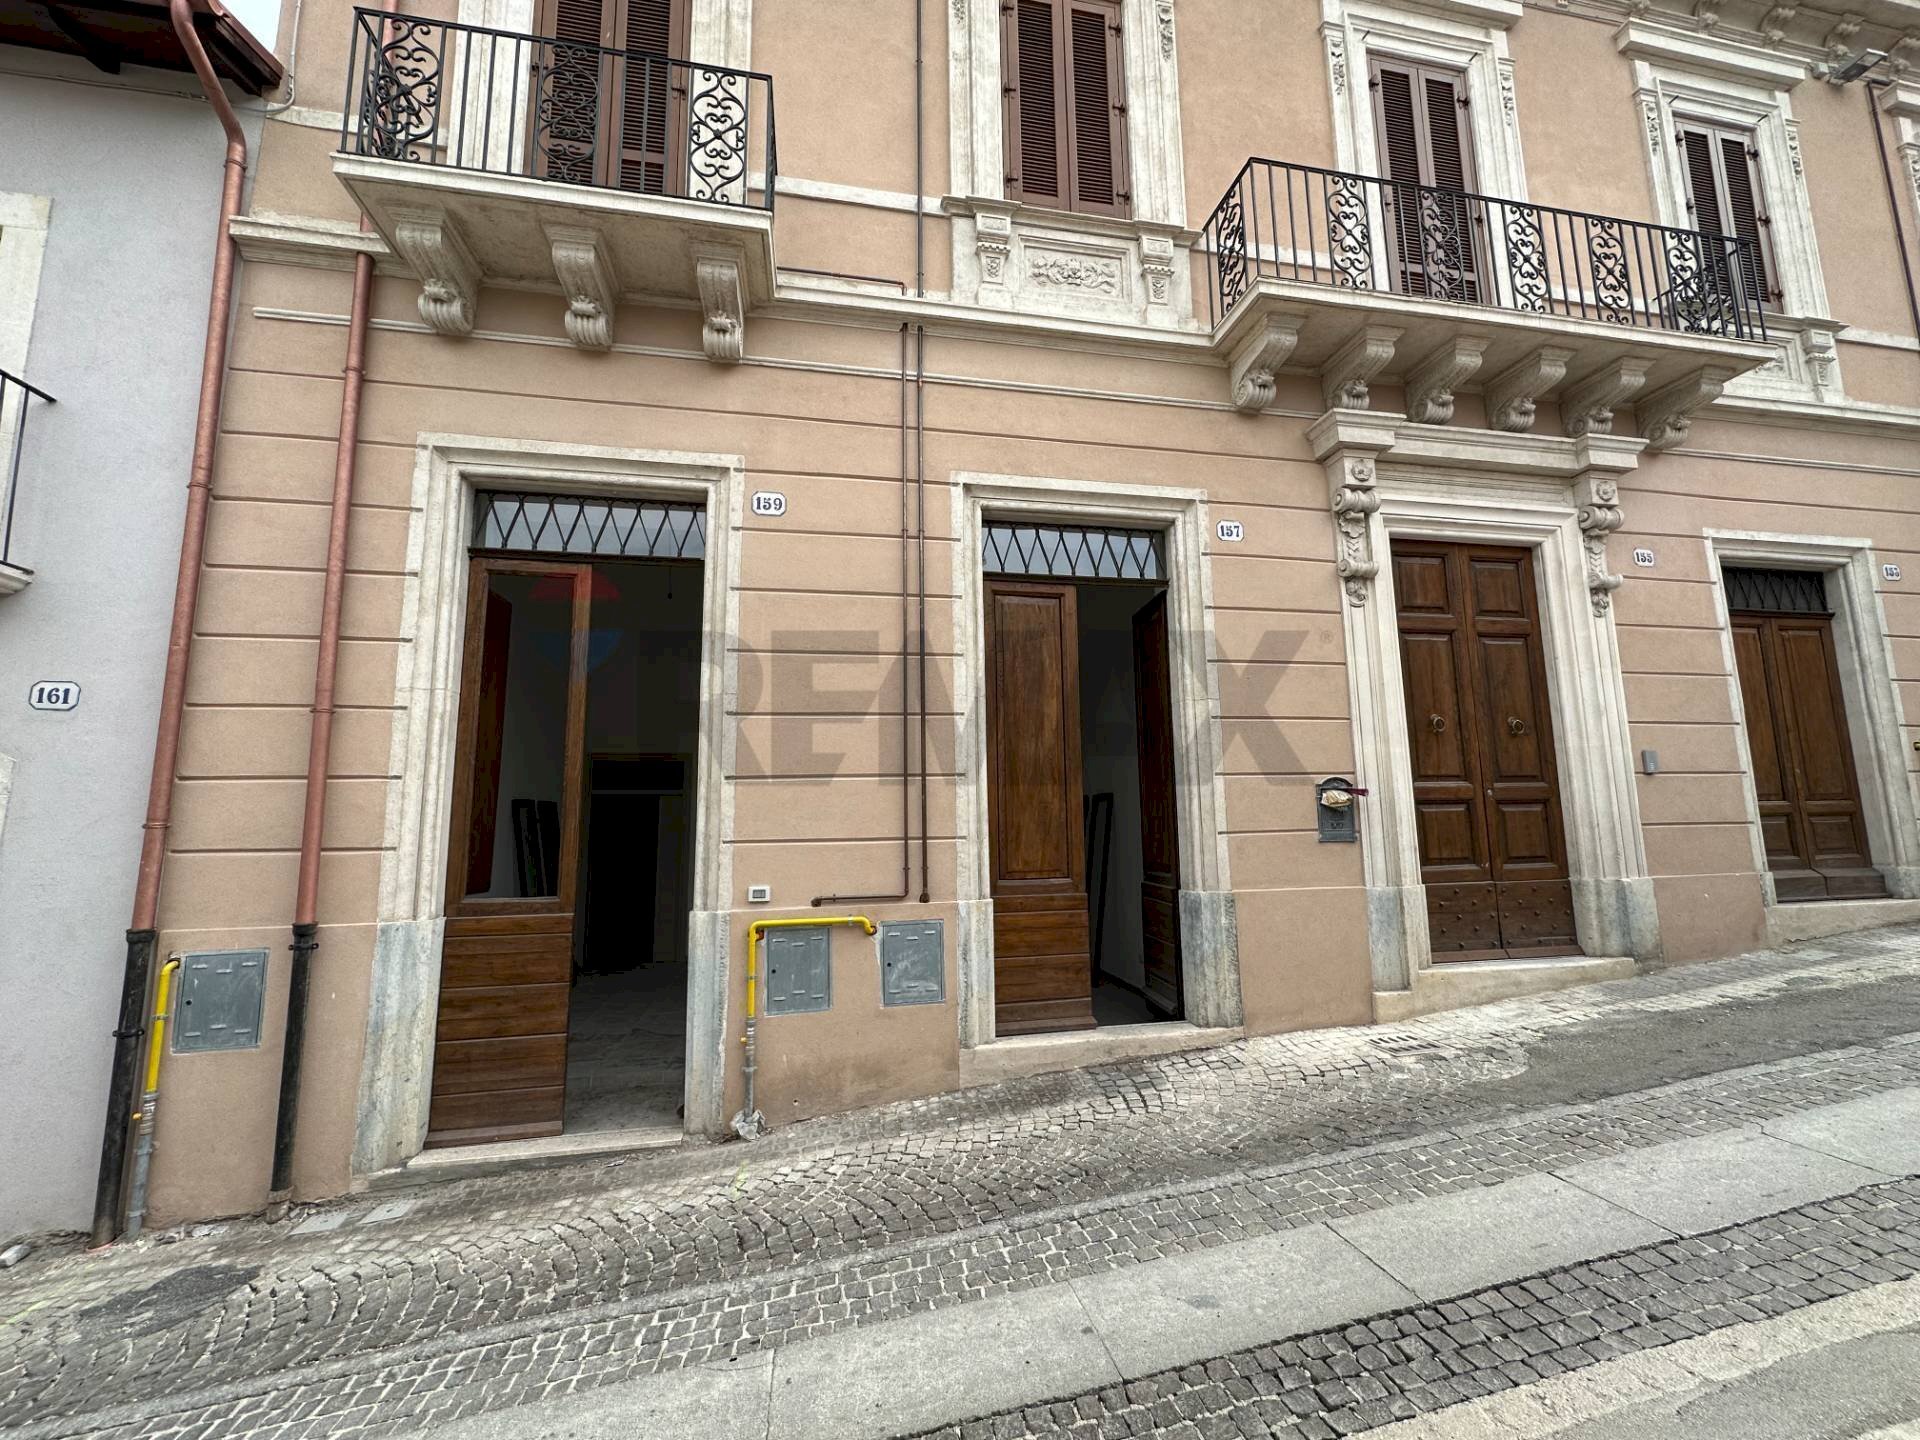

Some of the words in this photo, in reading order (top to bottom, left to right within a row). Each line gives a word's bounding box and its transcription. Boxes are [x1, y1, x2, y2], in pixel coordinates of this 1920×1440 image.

[756, 496, 783, 511] 159
[1220, 525, 1240, 538] 157
[36, 687, 71, 705] 161
